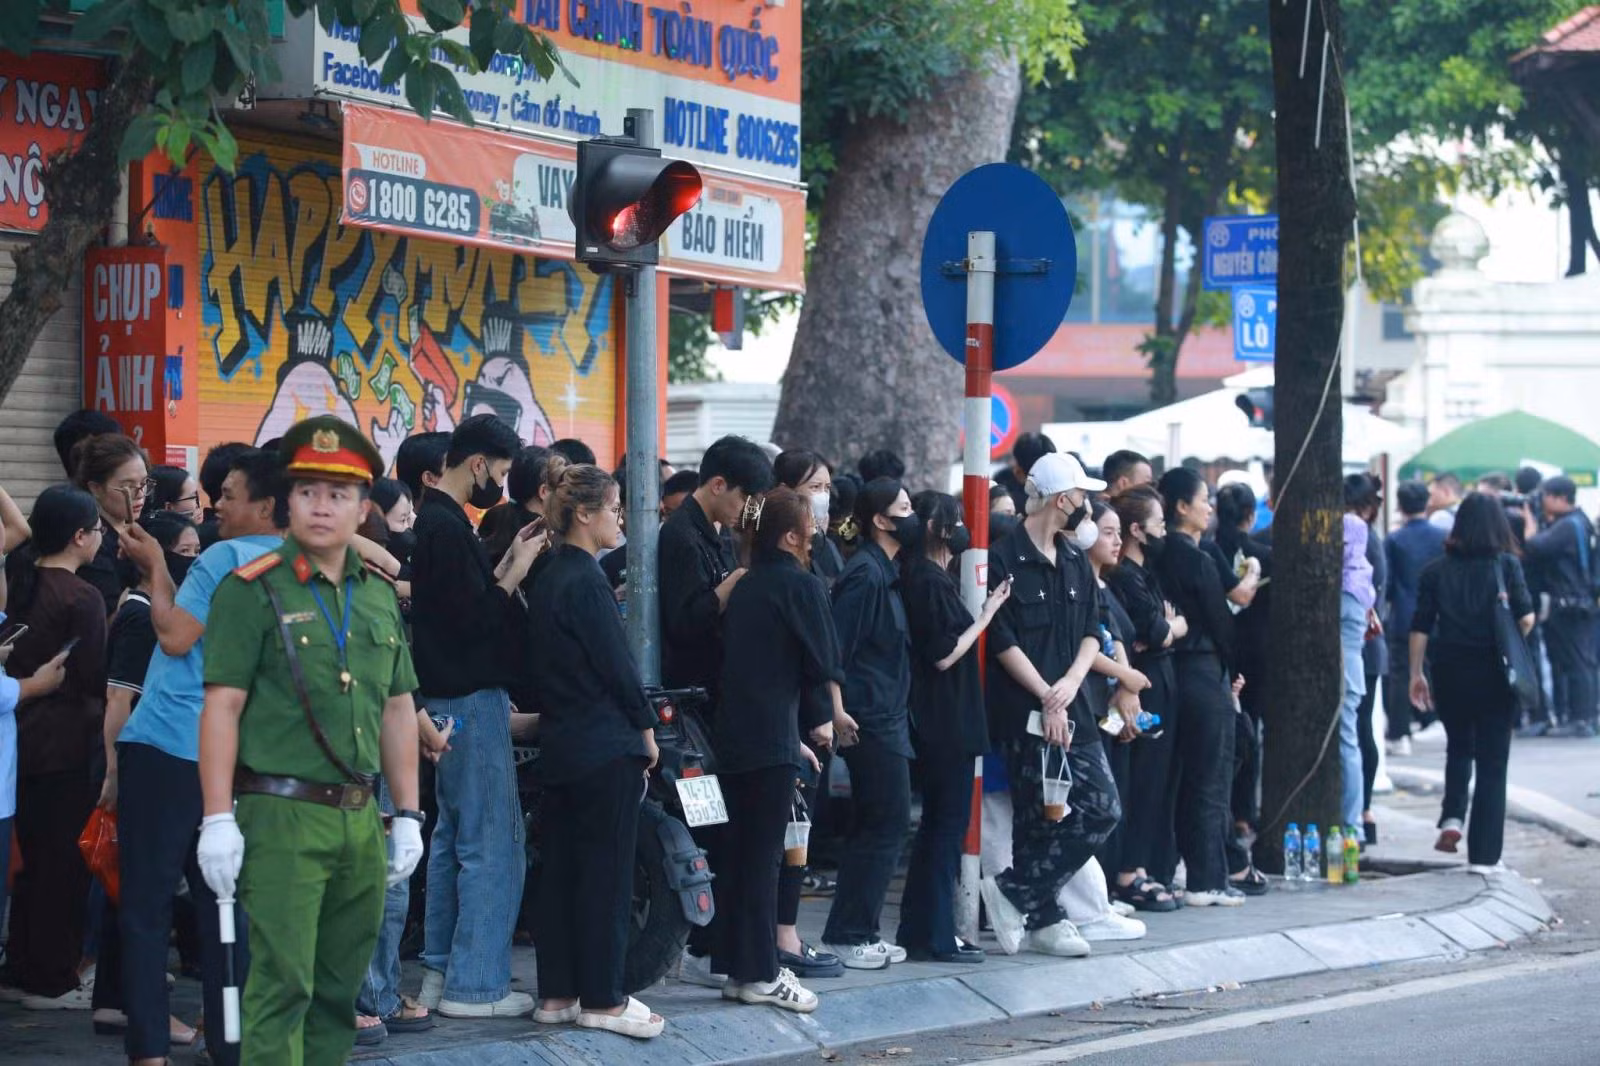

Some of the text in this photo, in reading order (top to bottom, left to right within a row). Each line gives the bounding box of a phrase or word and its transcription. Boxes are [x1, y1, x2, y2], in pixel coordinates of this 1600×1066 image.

[718, 5, 779, 83] QUỐC
[563, 104, 600, 137] nhanh
[664, 96, 798, 168] HOTLINE 8006285
[372, 151, 418, 175] HOTLINE
[538, 164, 575, 210] VAY
[369, 178, 471, 231] 1800 6285
[724, 205, 763, 262] HIỂM
[93, 262, 161, 335] CHỤP
[1242, 315, 1269, 348] LÒ
[95, 334, 155, 412] ẢNH
